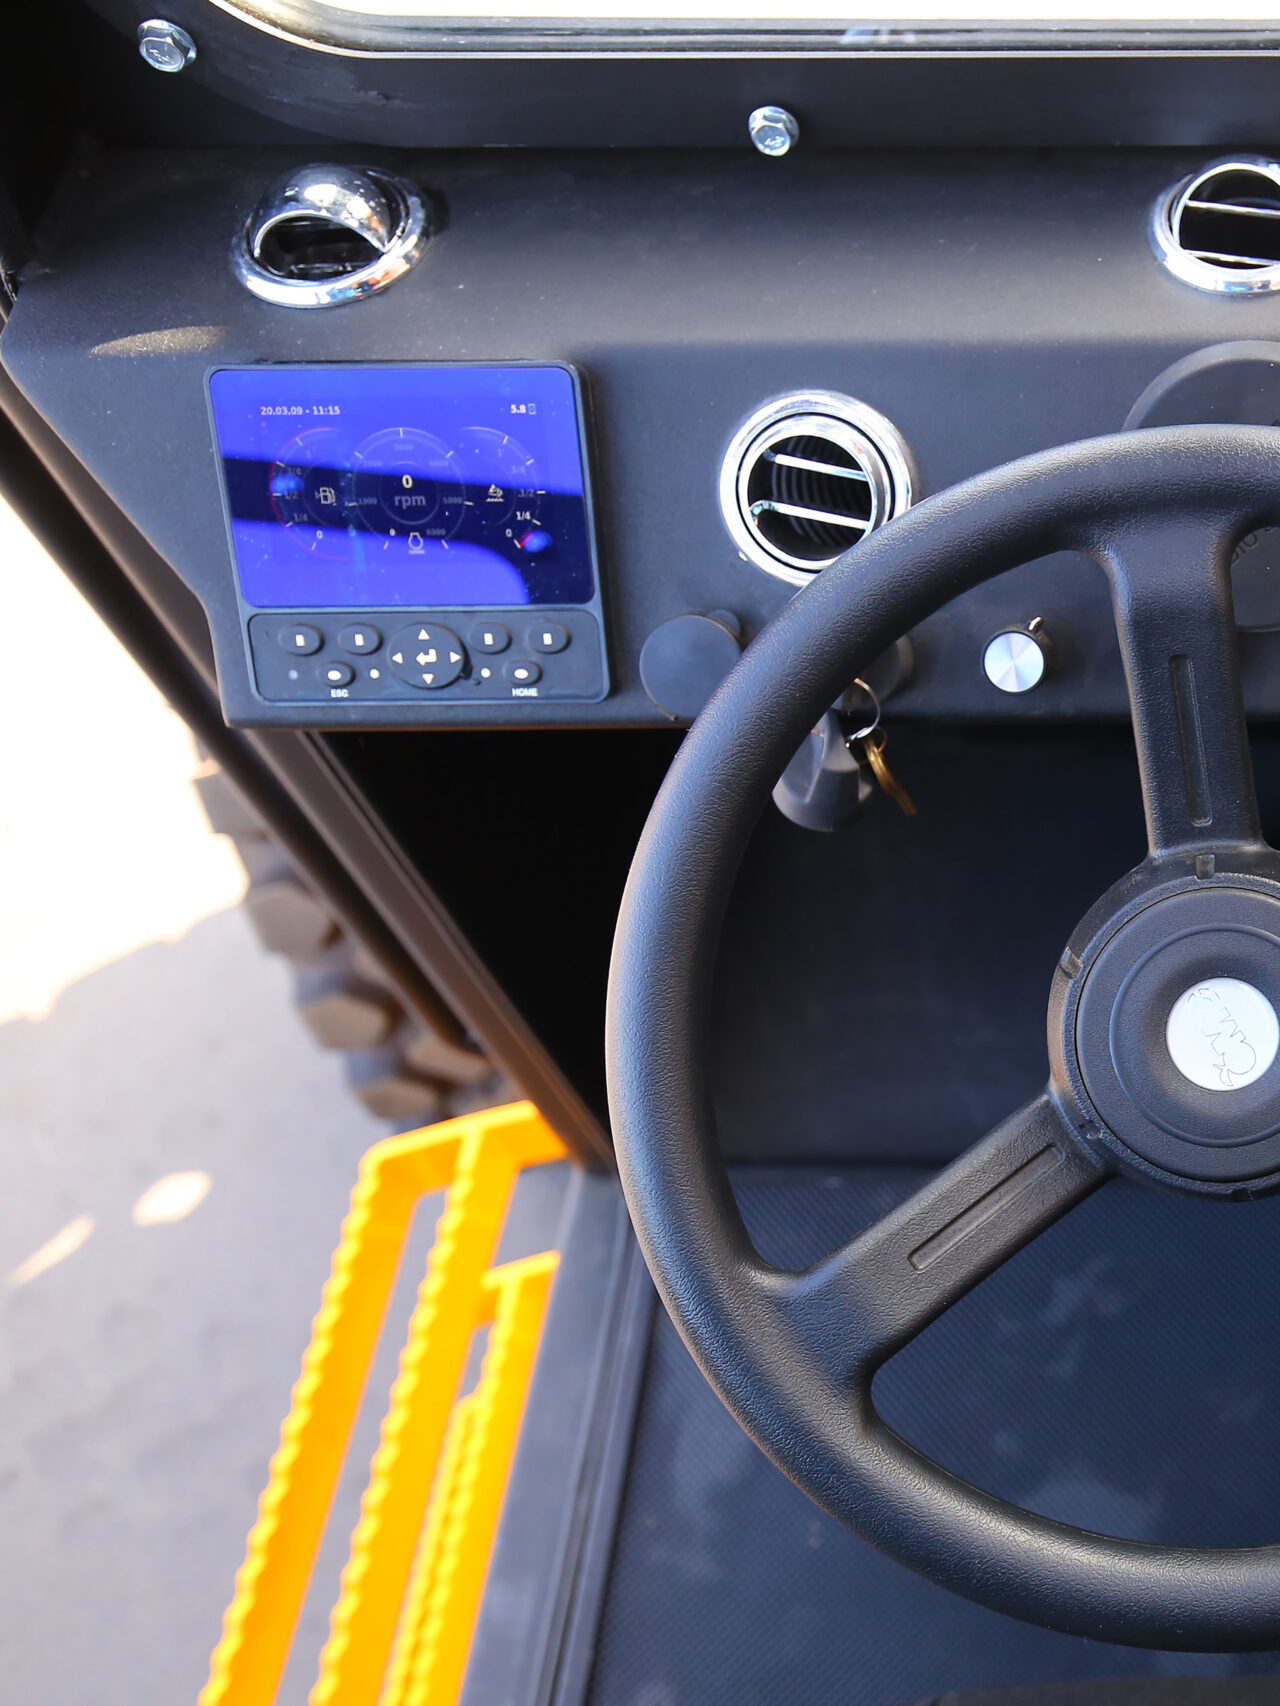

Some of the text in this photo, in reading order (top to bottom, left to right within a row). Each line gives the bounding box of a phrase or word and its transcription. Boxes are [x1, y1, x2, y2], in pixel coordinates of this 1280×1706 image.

[260, 405, 303, 416] 20.03.09
[312, 405, 341, 416] 11:15
[510, 403, 527, 414] 5.8
[401, 474, 413, 489] 0
[394, 495, 427, 510] rpm
[515, 511, 532, 521] 1/4
[330, 687, 350, 698] ESC
[511, 687, 539, 698] HOME
